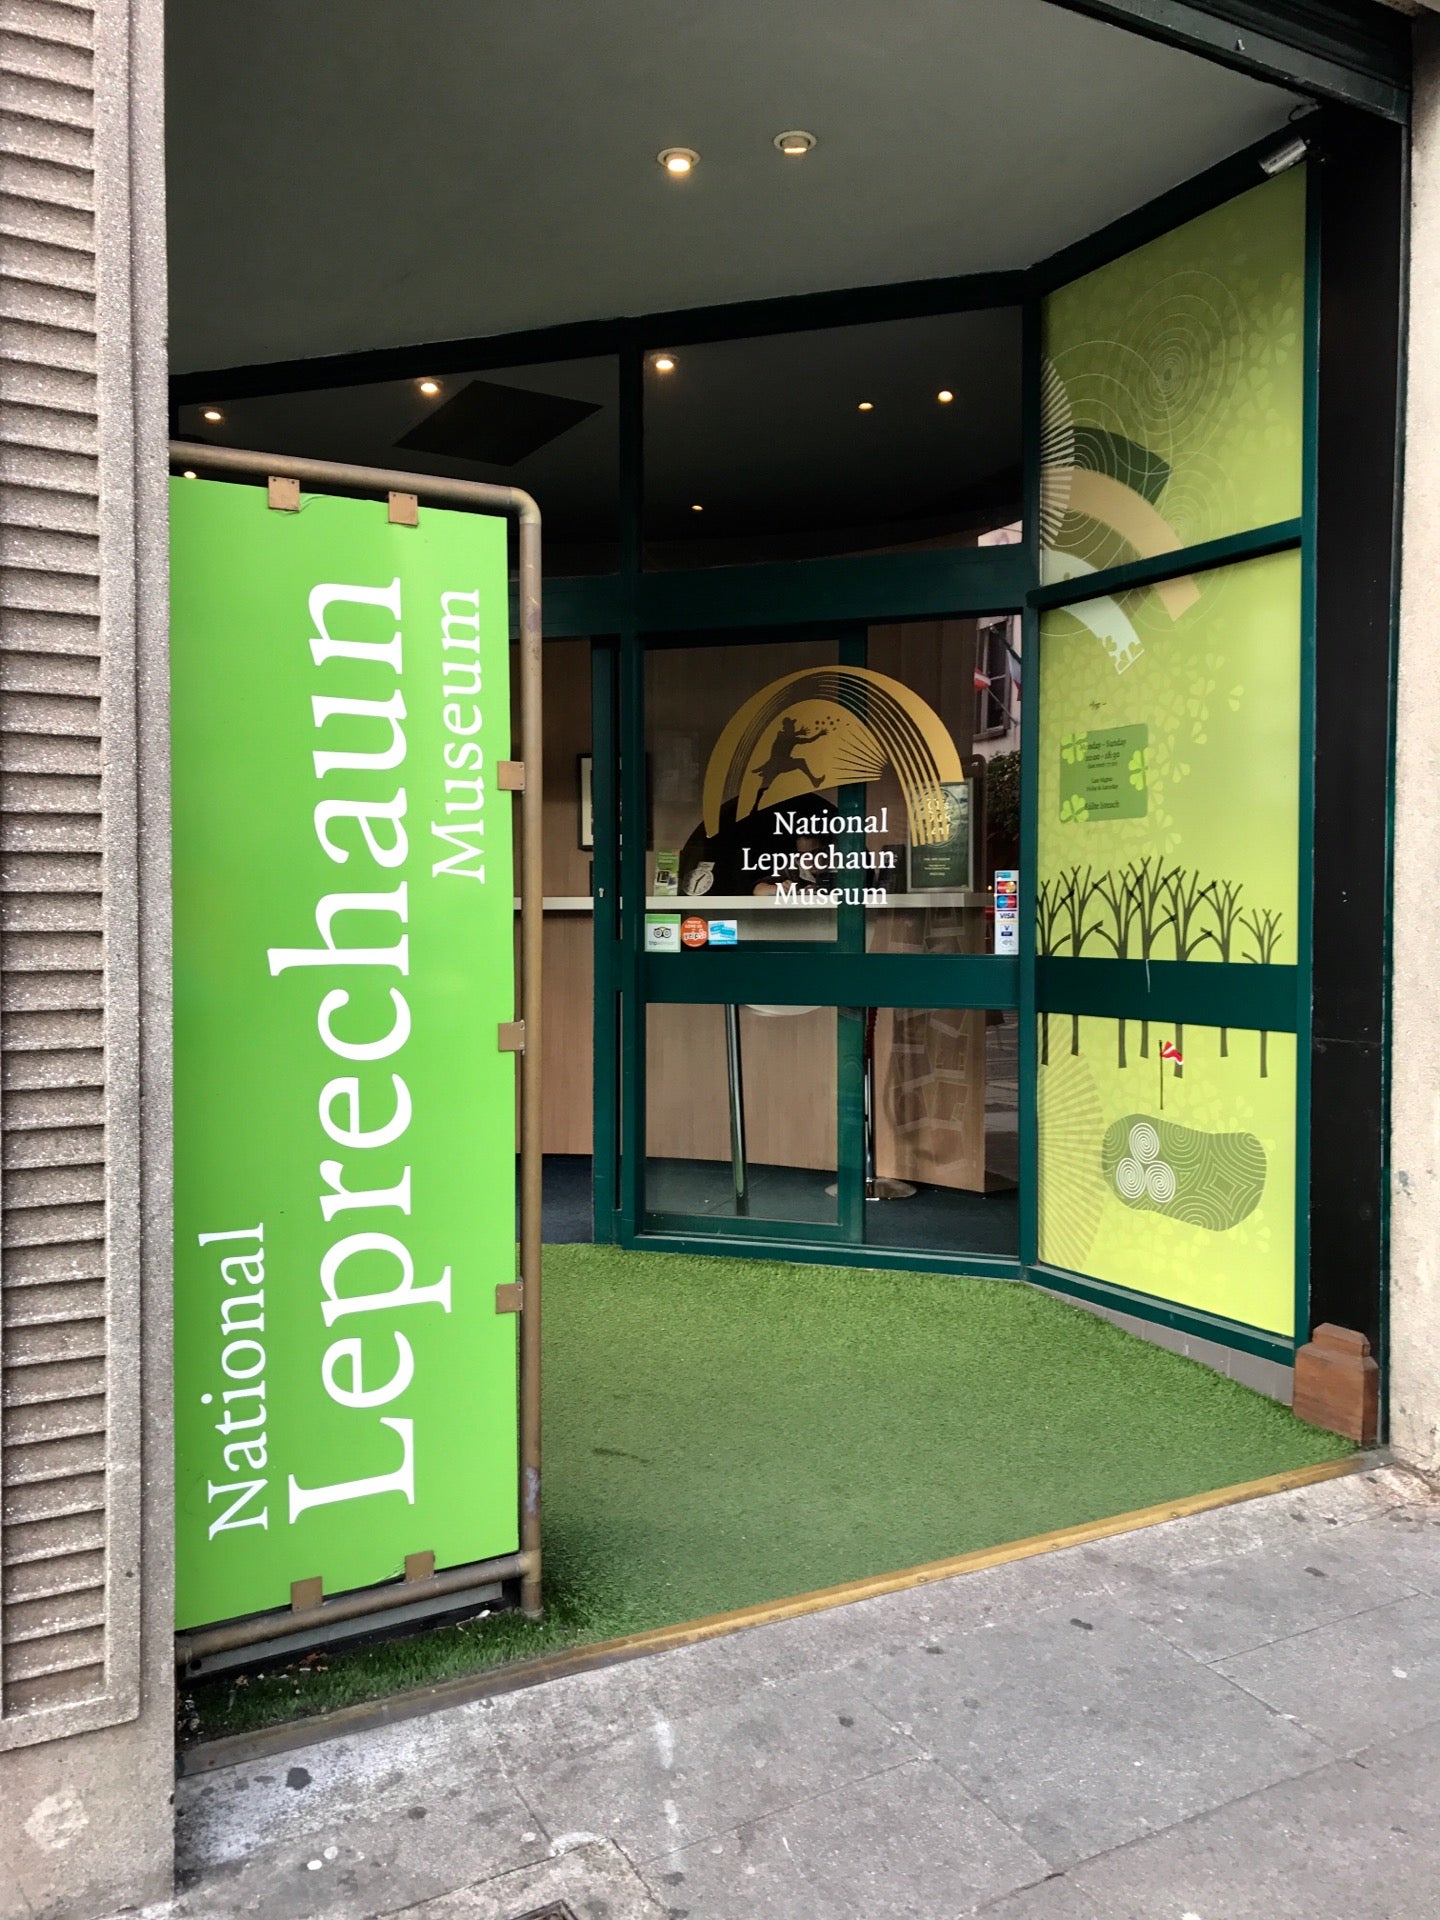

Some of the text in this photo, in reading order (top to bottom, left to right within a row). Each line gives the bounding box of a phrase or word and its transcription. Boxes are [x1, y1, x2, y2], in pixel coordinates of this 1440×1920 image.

[431, 588, 486, 884] Museum
[741, 844, 896, 877] Leprechaun
[774, 808, 888, 835] National
[774, 882, 888, 906] Museum
[267, 577, 453, 1525] Leprechaun
[198, 1222, 269, 1541] National
